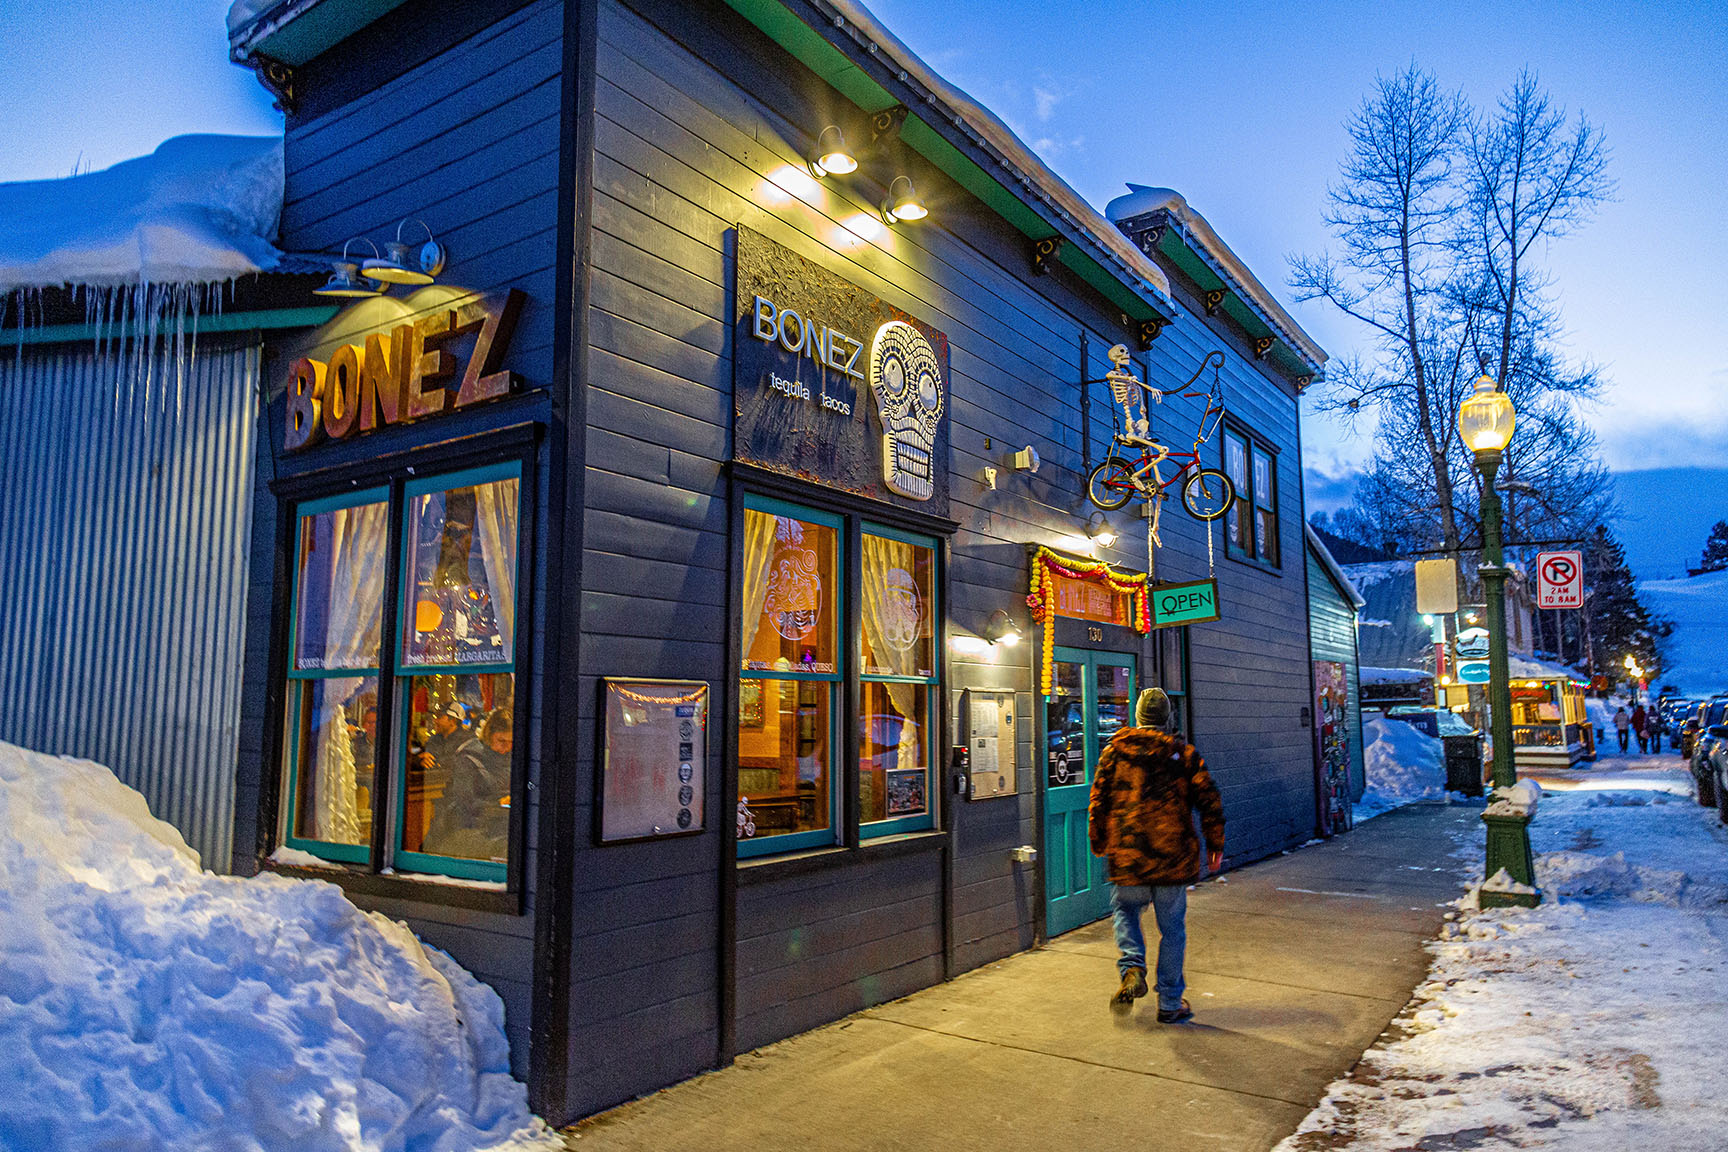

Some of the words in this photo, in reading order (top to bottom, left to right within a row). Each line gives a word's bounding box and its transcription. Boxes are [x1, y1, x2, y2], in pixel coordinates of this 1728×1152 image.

[753, 295, 865, 380] BONEZ
[284, 288, 526, 450] BONEZ
[770, 372, 810, 401] tequila
[821, 391, 851, 416] tacos
[1160, 591, 1212, 617] OPEN
[1545, 595, 1554, 603] TO
[1088, 627, 1103, 642] 130
